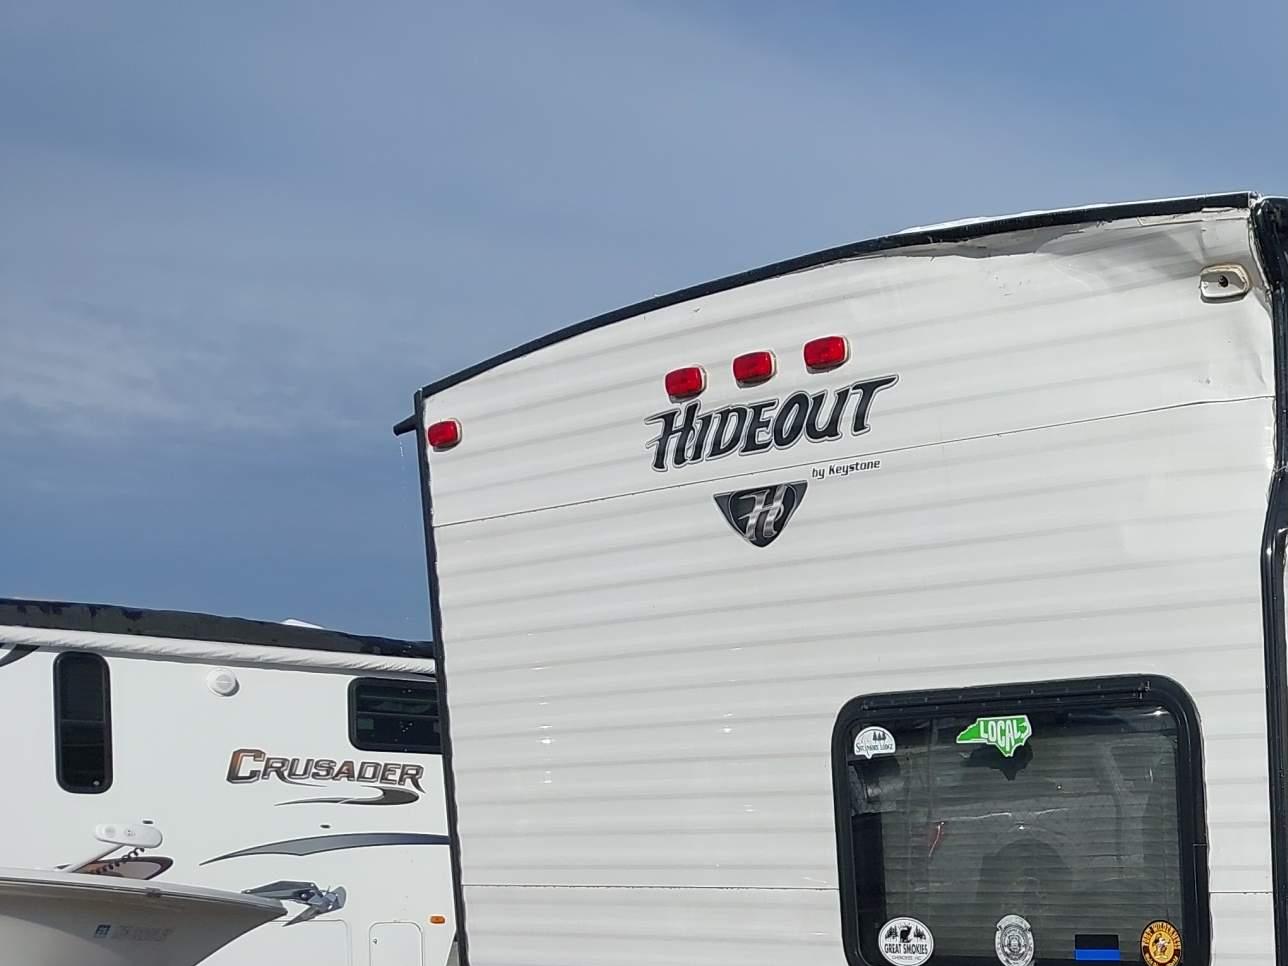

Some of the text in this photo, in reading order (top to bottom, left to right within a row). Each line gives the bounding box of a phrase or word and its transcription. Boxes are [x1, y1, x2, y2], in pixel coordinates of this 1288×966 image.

[643, 374, 900, 472] HIDEOUT
[811, 459, 881, 480] by Keystone
[980, 719, 1021, 752] LOCAL
[226, 748, 426, 793] CRUSADER
[884, 943, 928, 955] GREAT SMOKIES
